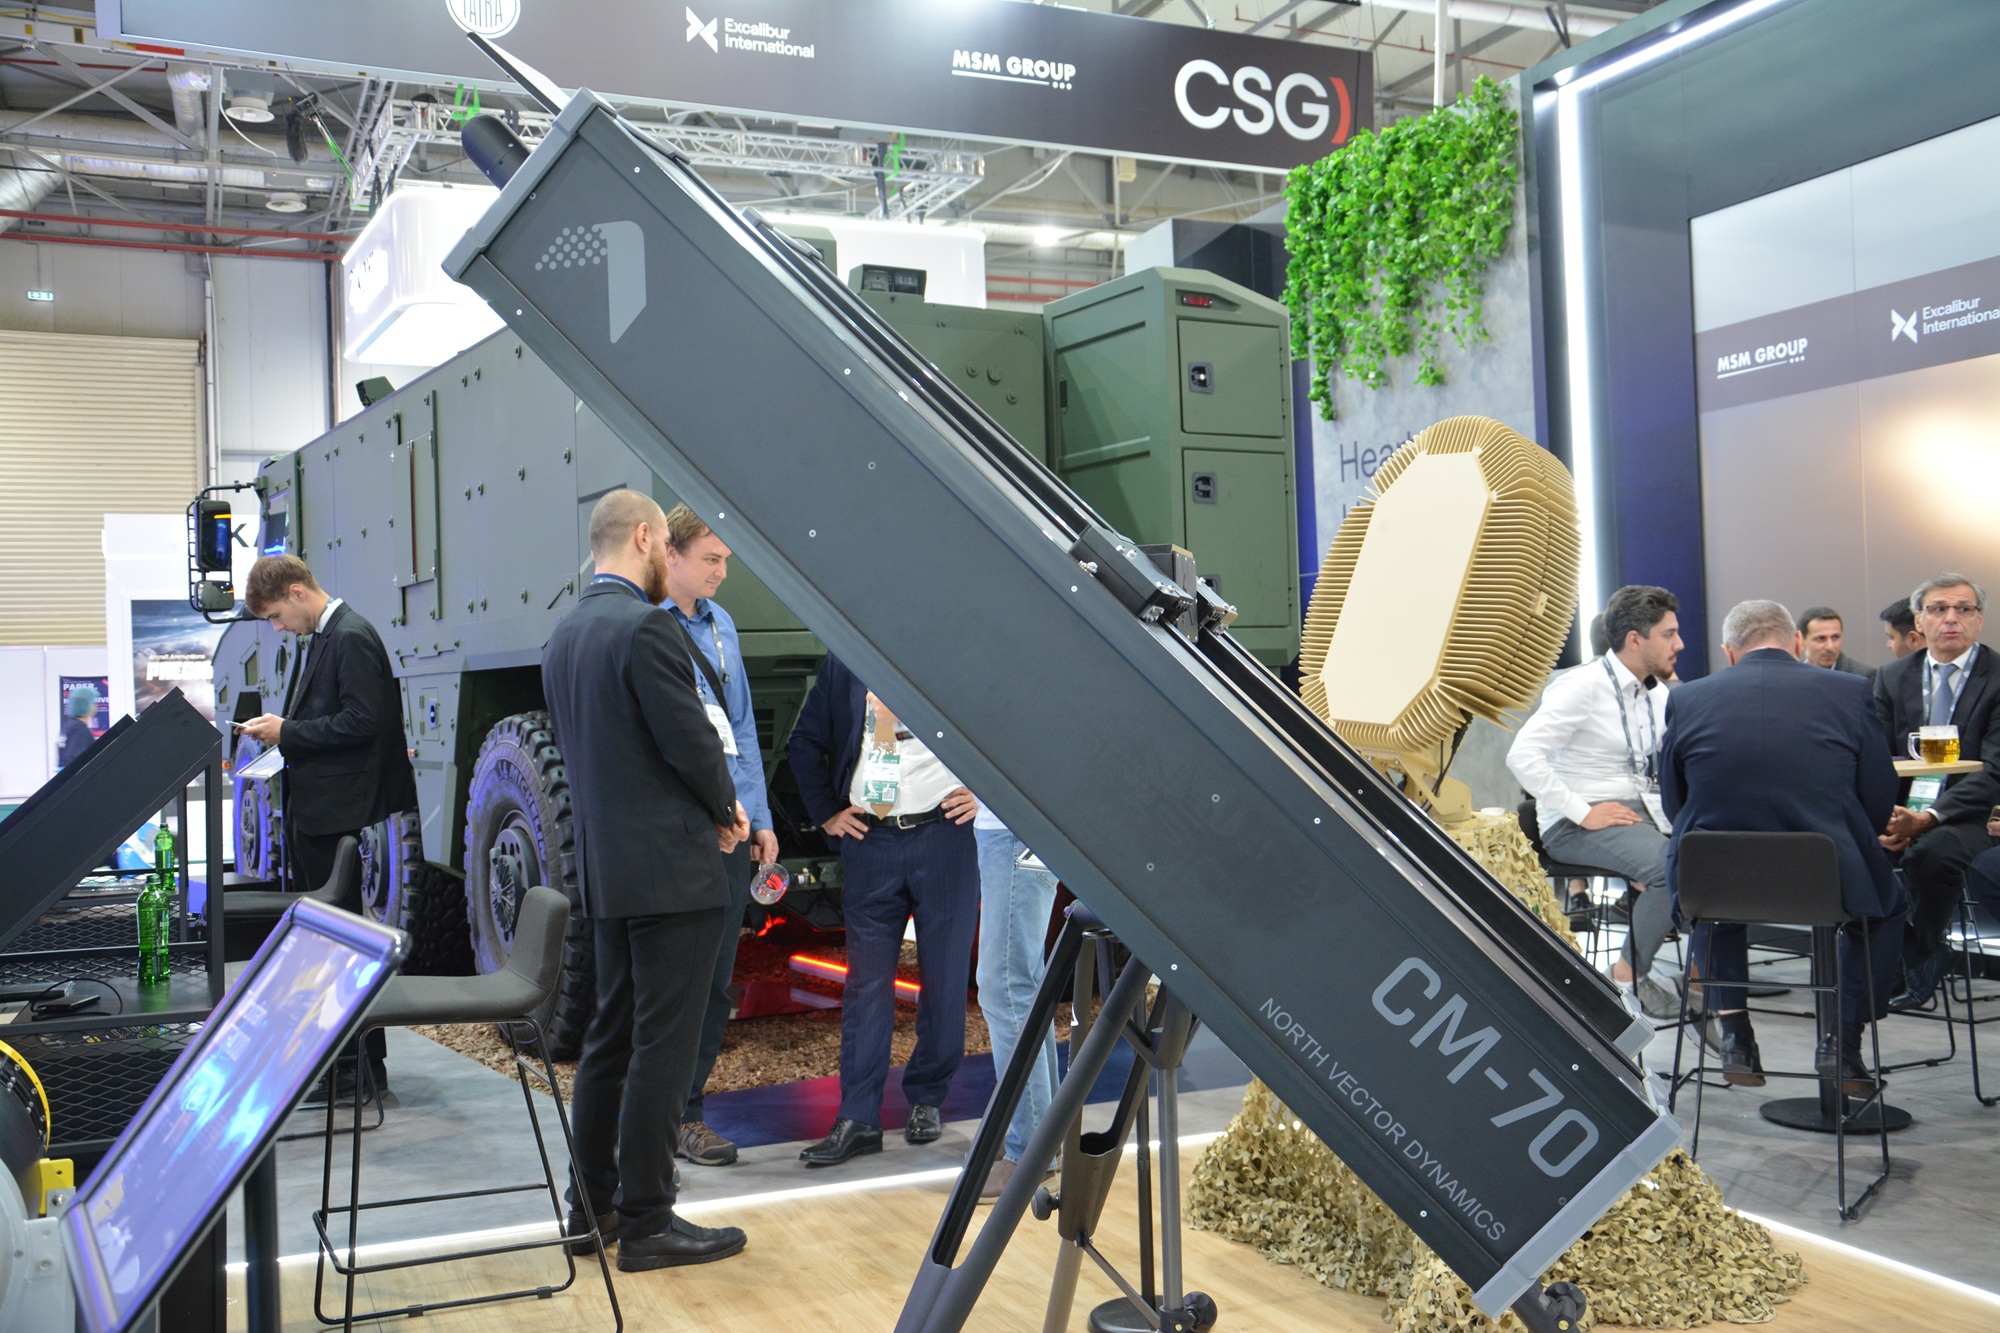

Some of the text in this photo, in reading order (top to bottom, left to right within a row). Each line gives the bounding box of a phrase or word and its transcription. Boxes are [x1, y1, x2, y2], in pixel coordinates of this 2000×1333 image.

[724, 17, 790, 40] Excalibur
[724, 33, 815, 59] International
[952, 49, 1076, 82] MSM GROUP
[1922, 297, 1981, 320] Excalibur
[1717, 338, 1808, 372] MSM GROUP
[1340, 431, 1414, 483] Hea
[508, 763, 547, 862] MICHELIN
[1372, 957, 1600, 1178] CM-70
[1259, 997, 1506, 1241] NORTH VECTOR DYNAMICS
